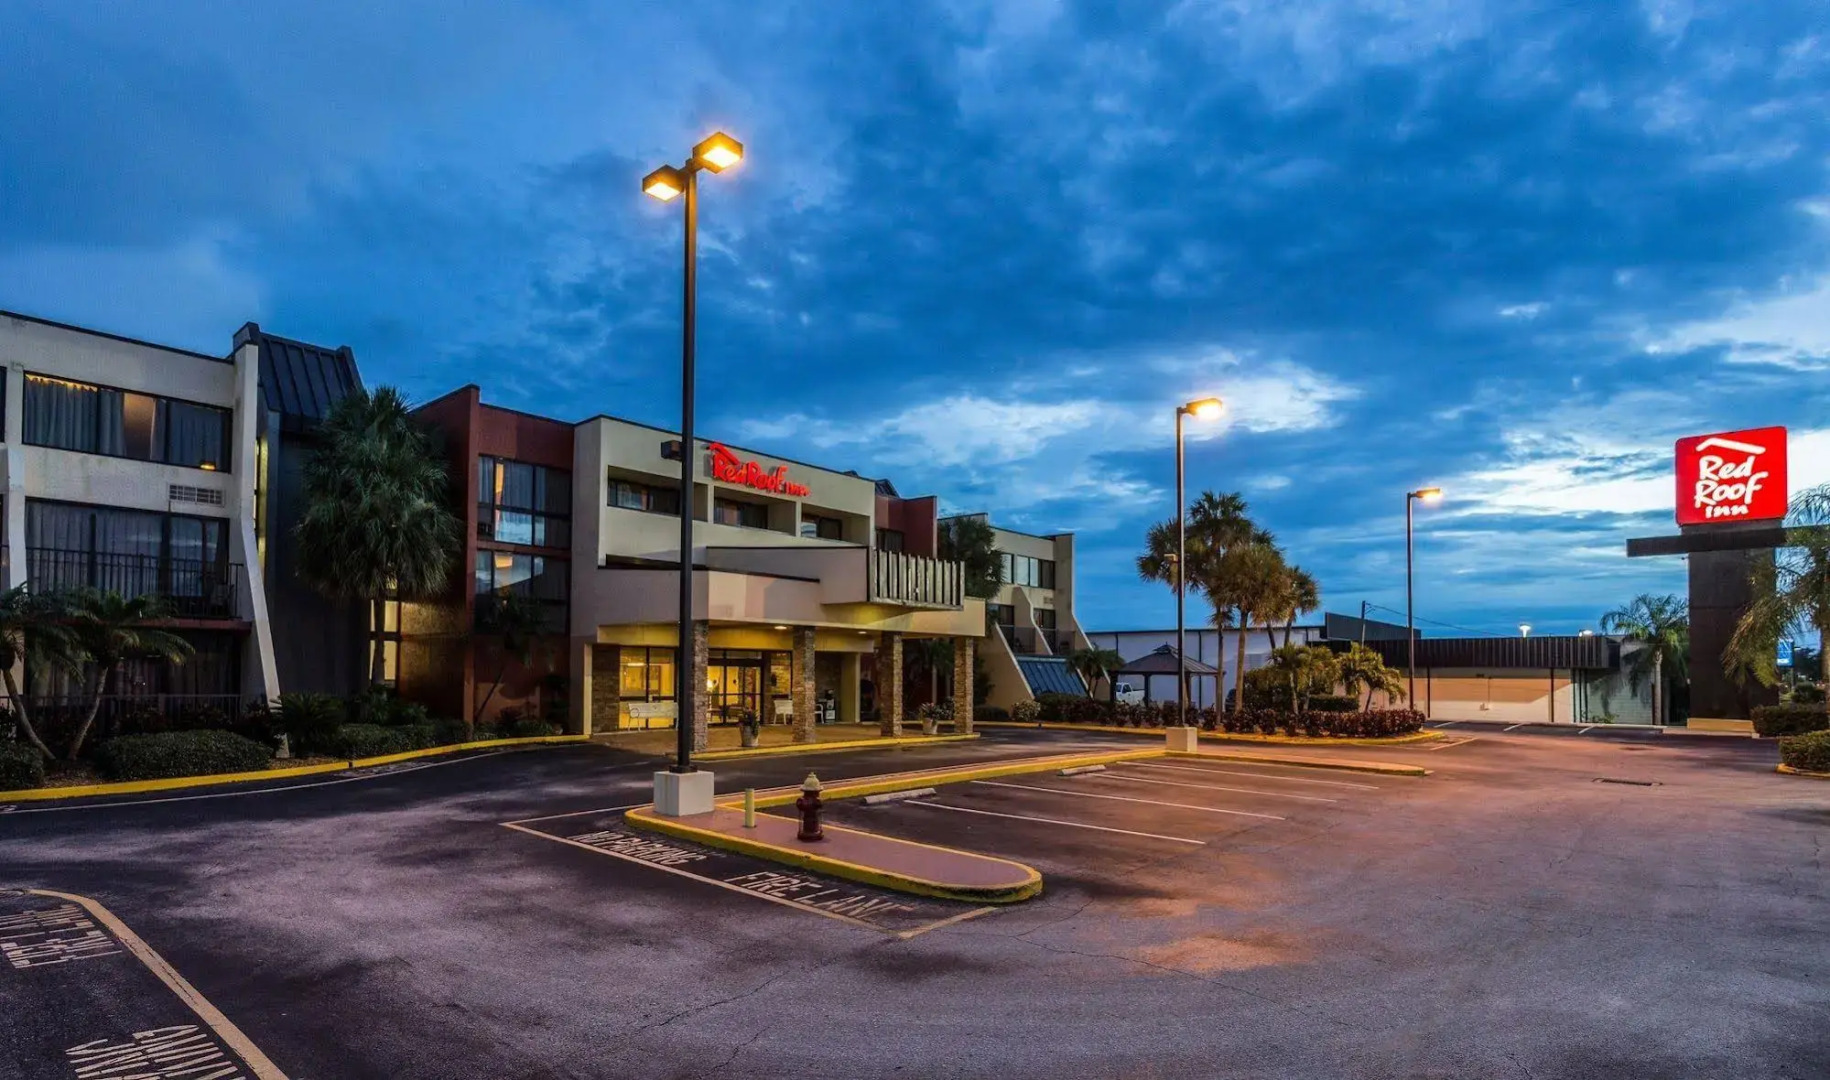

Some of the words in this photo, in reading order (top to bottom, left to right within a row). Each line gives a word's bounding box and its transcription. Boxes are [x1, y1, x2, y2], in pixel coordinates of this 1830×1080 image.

[712, 454, 746, 483] Red
[746, 461, 788, 493] Roof
[1699, 455, 1756, 481] Red
[1694, 471, 1769, 508] Roof
[723, 871, 822, 896] FIRE
